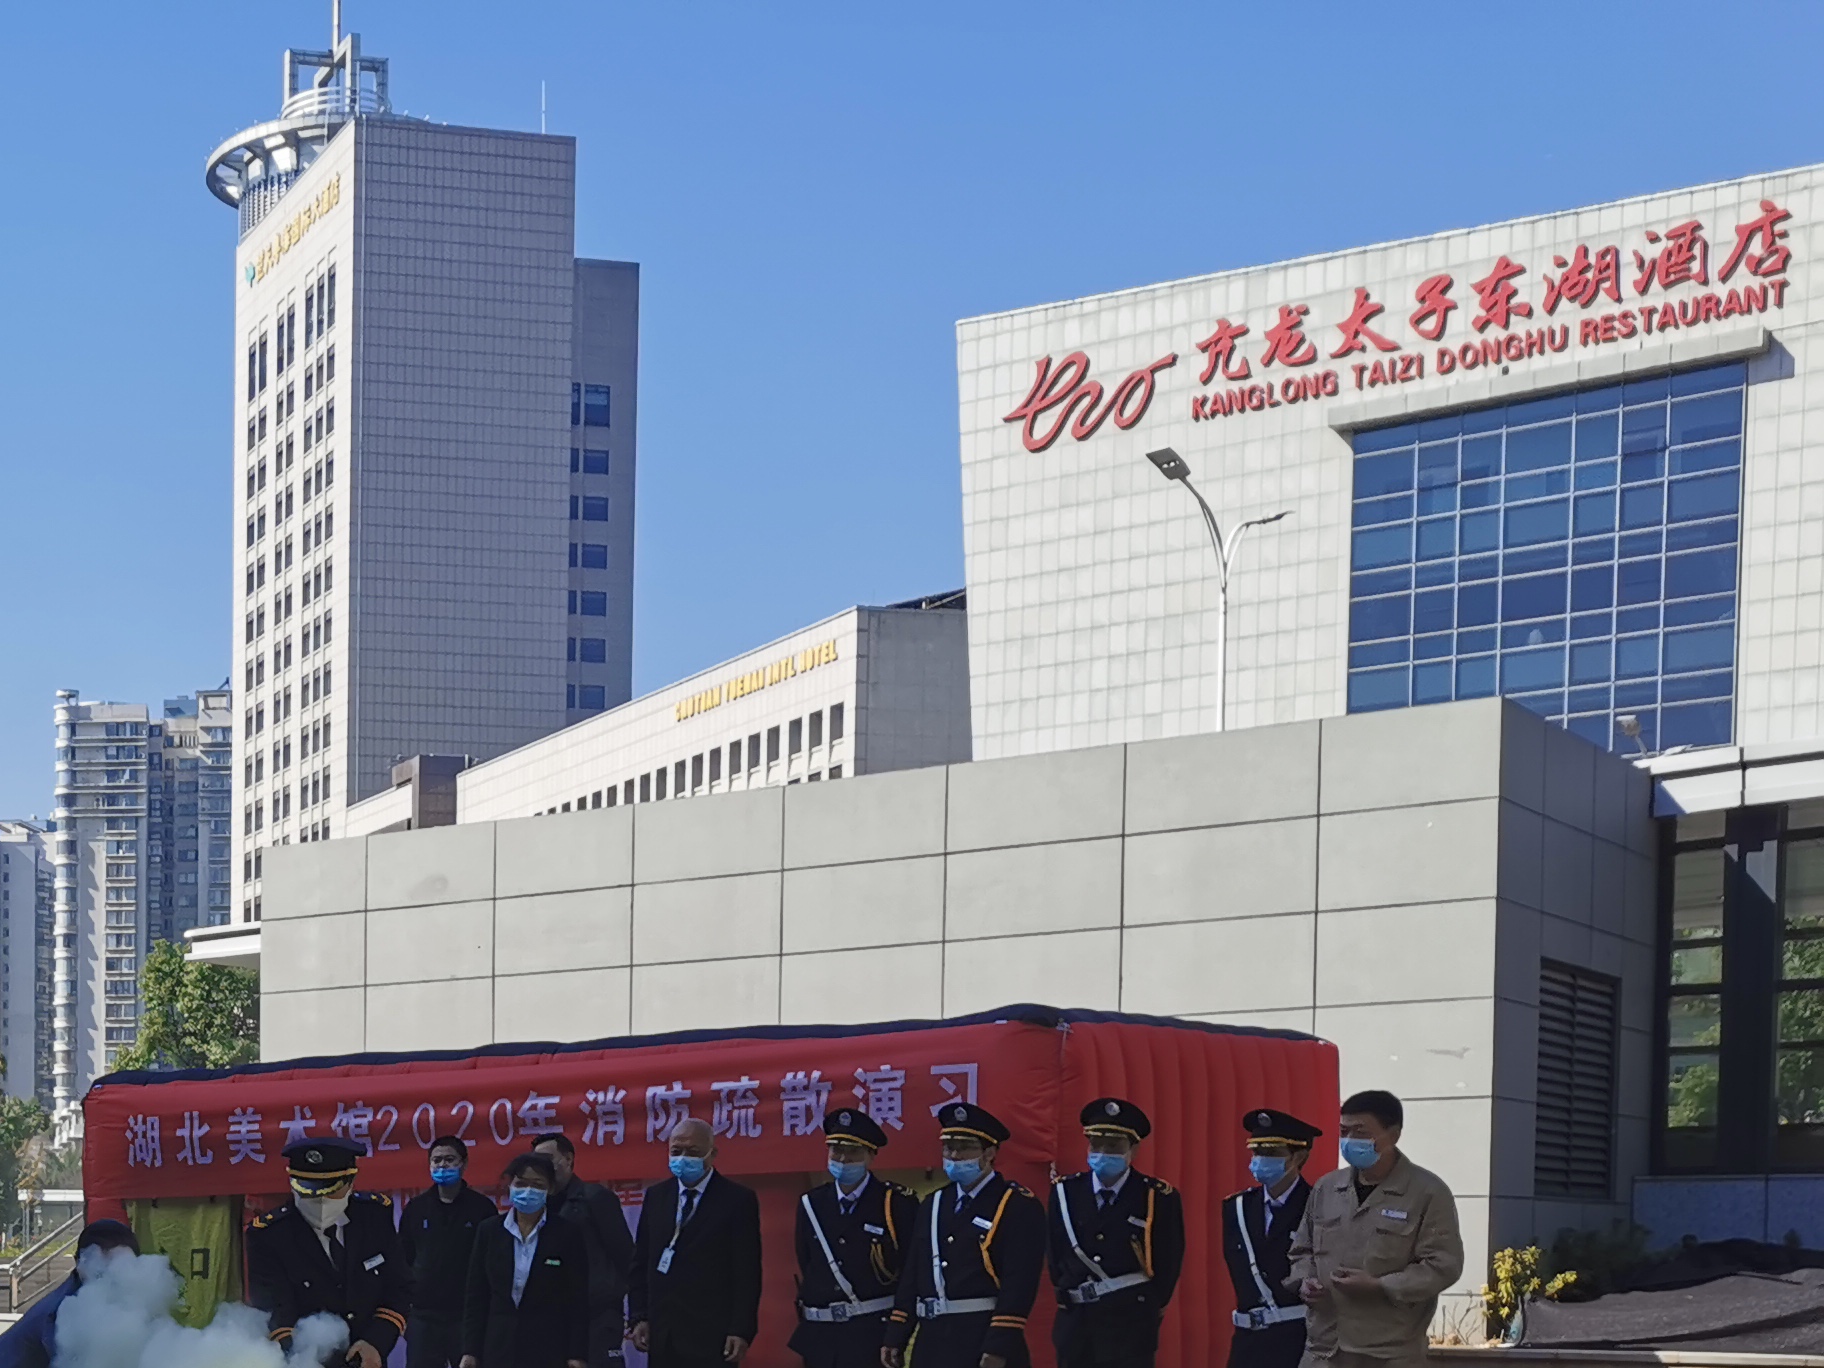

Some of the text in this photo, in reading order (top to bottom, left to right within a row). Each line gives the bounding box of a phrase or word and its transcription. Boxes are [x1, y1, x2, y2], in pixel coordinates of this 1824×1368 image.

[1191, 278, 1789, 422] KANGLONG TAIZI DONGHU RESTAURANT
[1195, 199, 1793, 386] 亢龙太子东湖酒店
